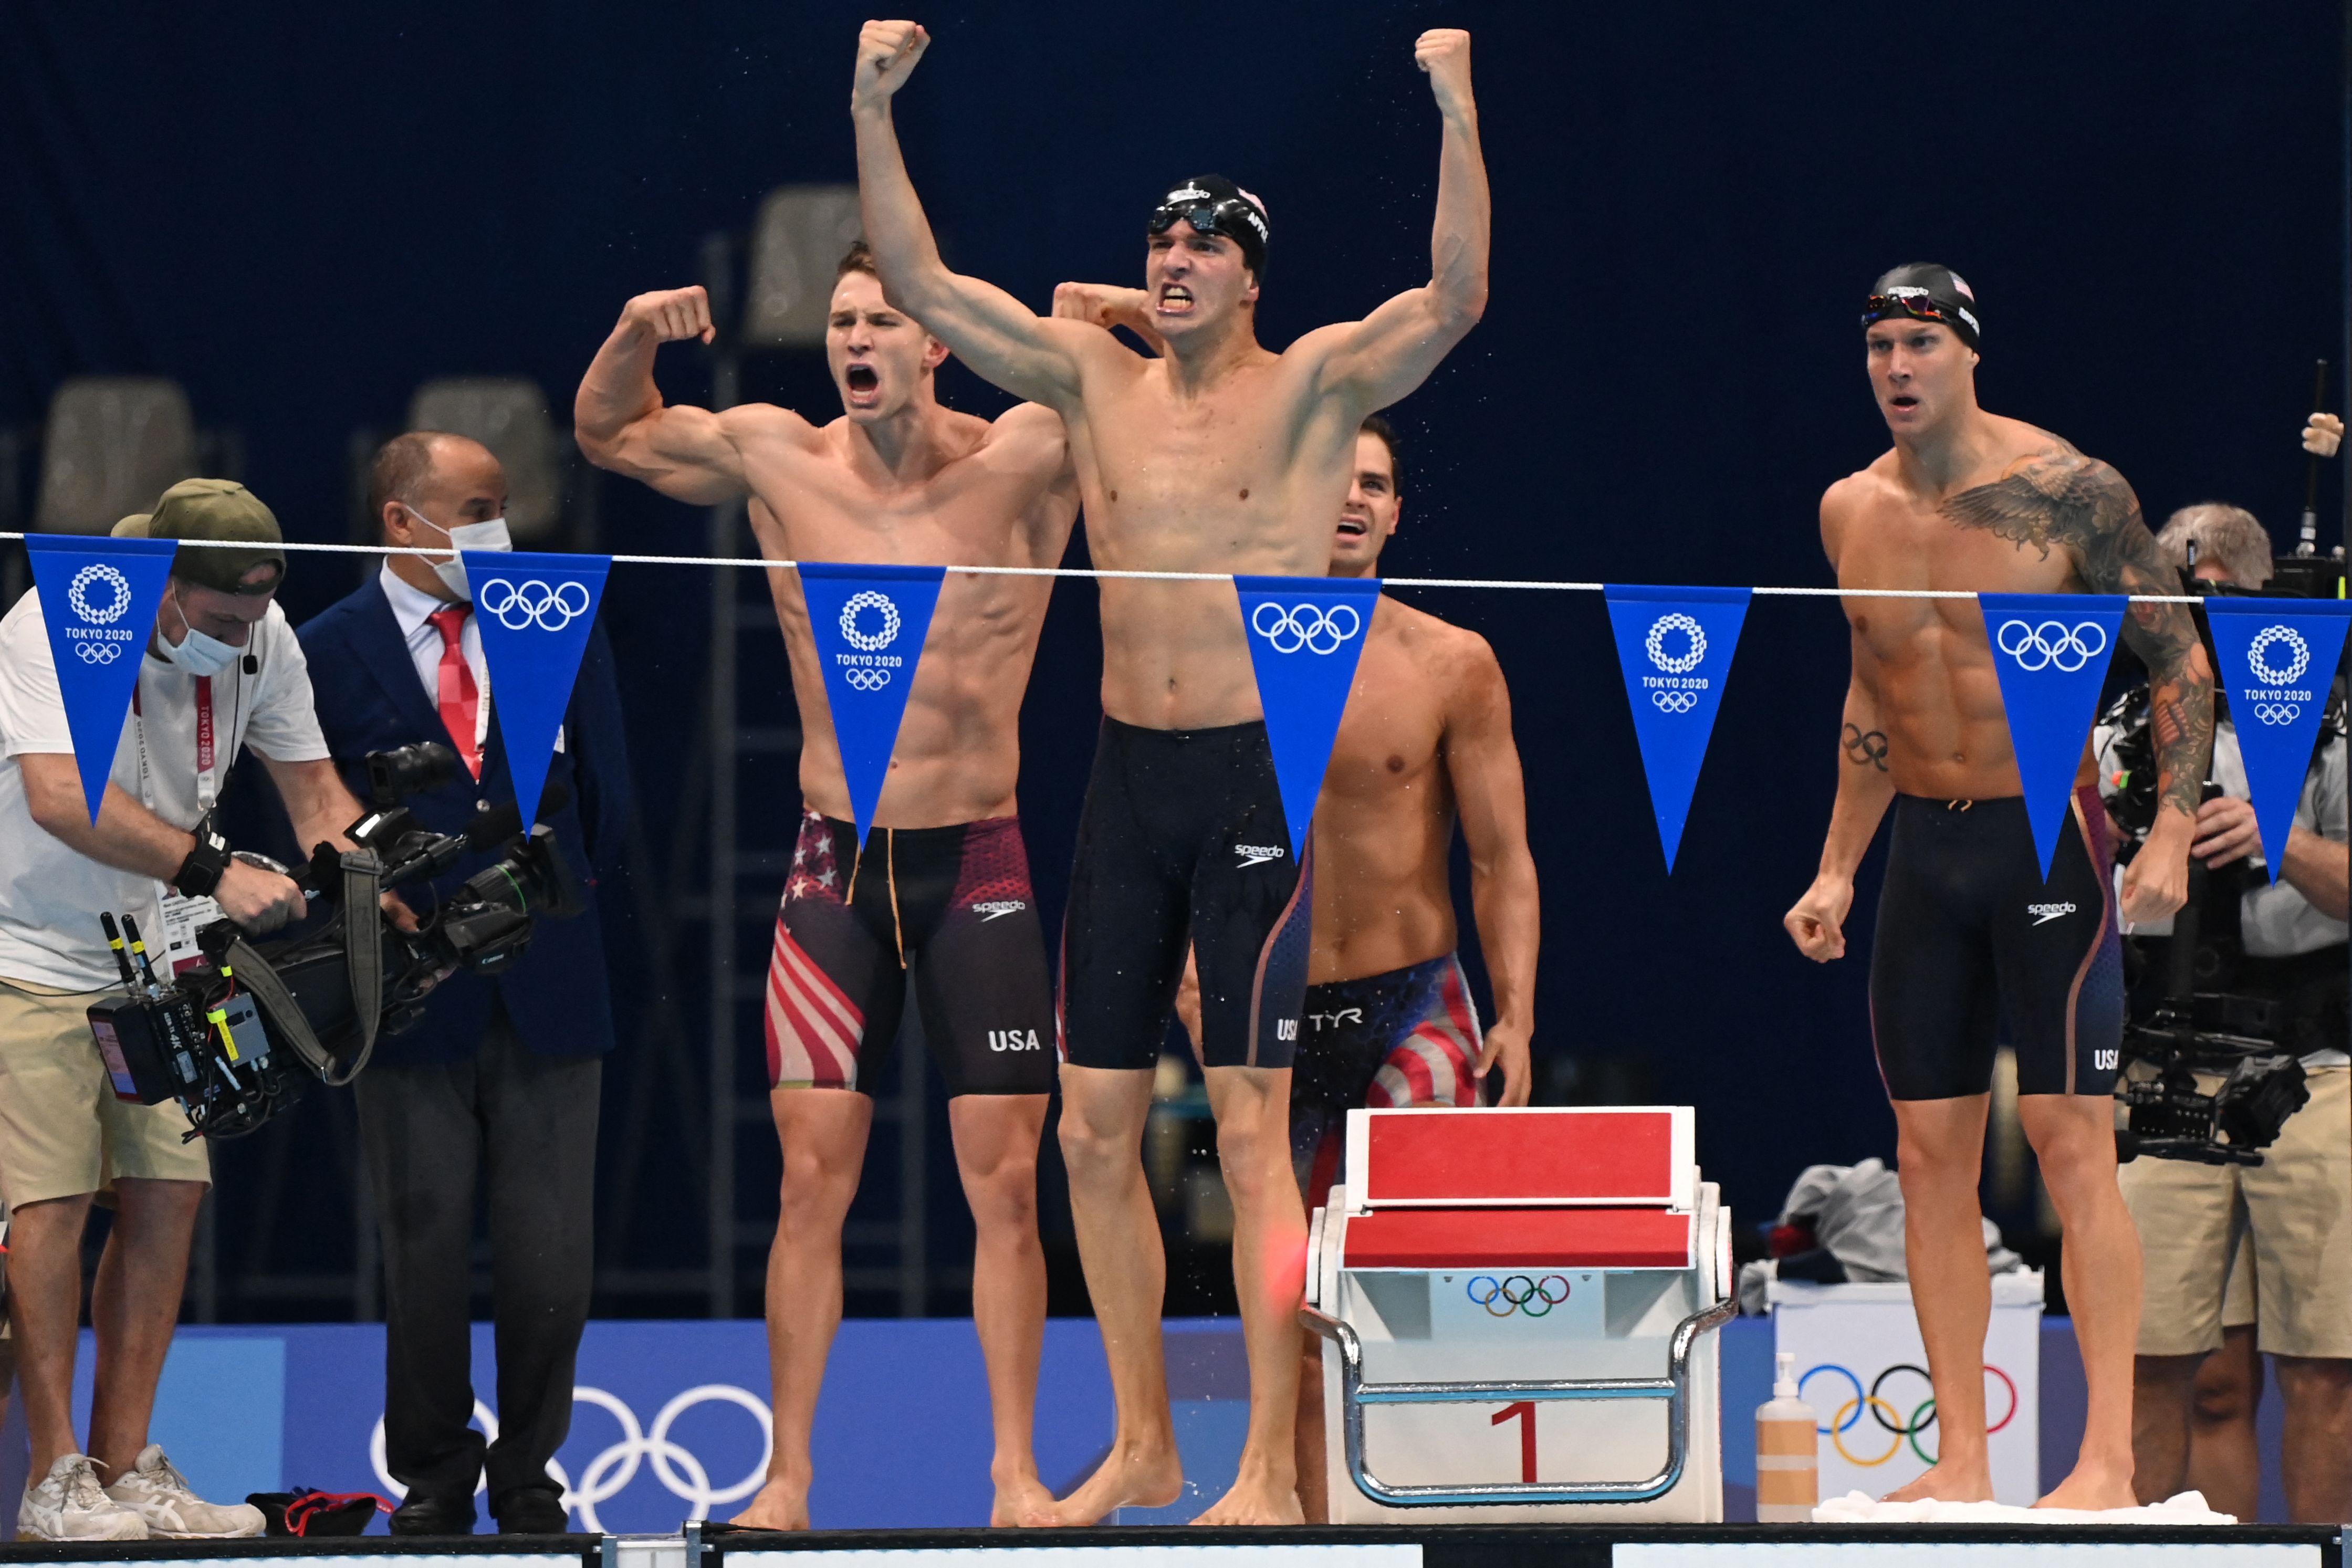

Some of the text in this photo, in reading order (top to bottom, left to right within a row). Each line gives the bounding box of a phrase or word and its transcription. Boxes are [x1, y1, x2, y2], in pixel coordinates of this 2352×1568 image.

[65, 628, 133, 641] TOKYO 2020
[836, 654, 902, 667] TOKYO 2020
[1643, 676, 1708, 689] TOKYO 2020
[2244, 689, 2312, 701] TOKYO 2020
[201, 706, 211, 766] TOKYO 2020
[1234, 844, 1284, 858] speedo
[972, 900, 1026, 913] speedo
[2027, 901, 2077, 916] speedo
[1309, 1007, 1363, 1032] TYR
[170, 1034, 183, 1049] 4K
[988, 1029, 1040, 1052] USA
[1491, 1402, 1537, 1483] 1
